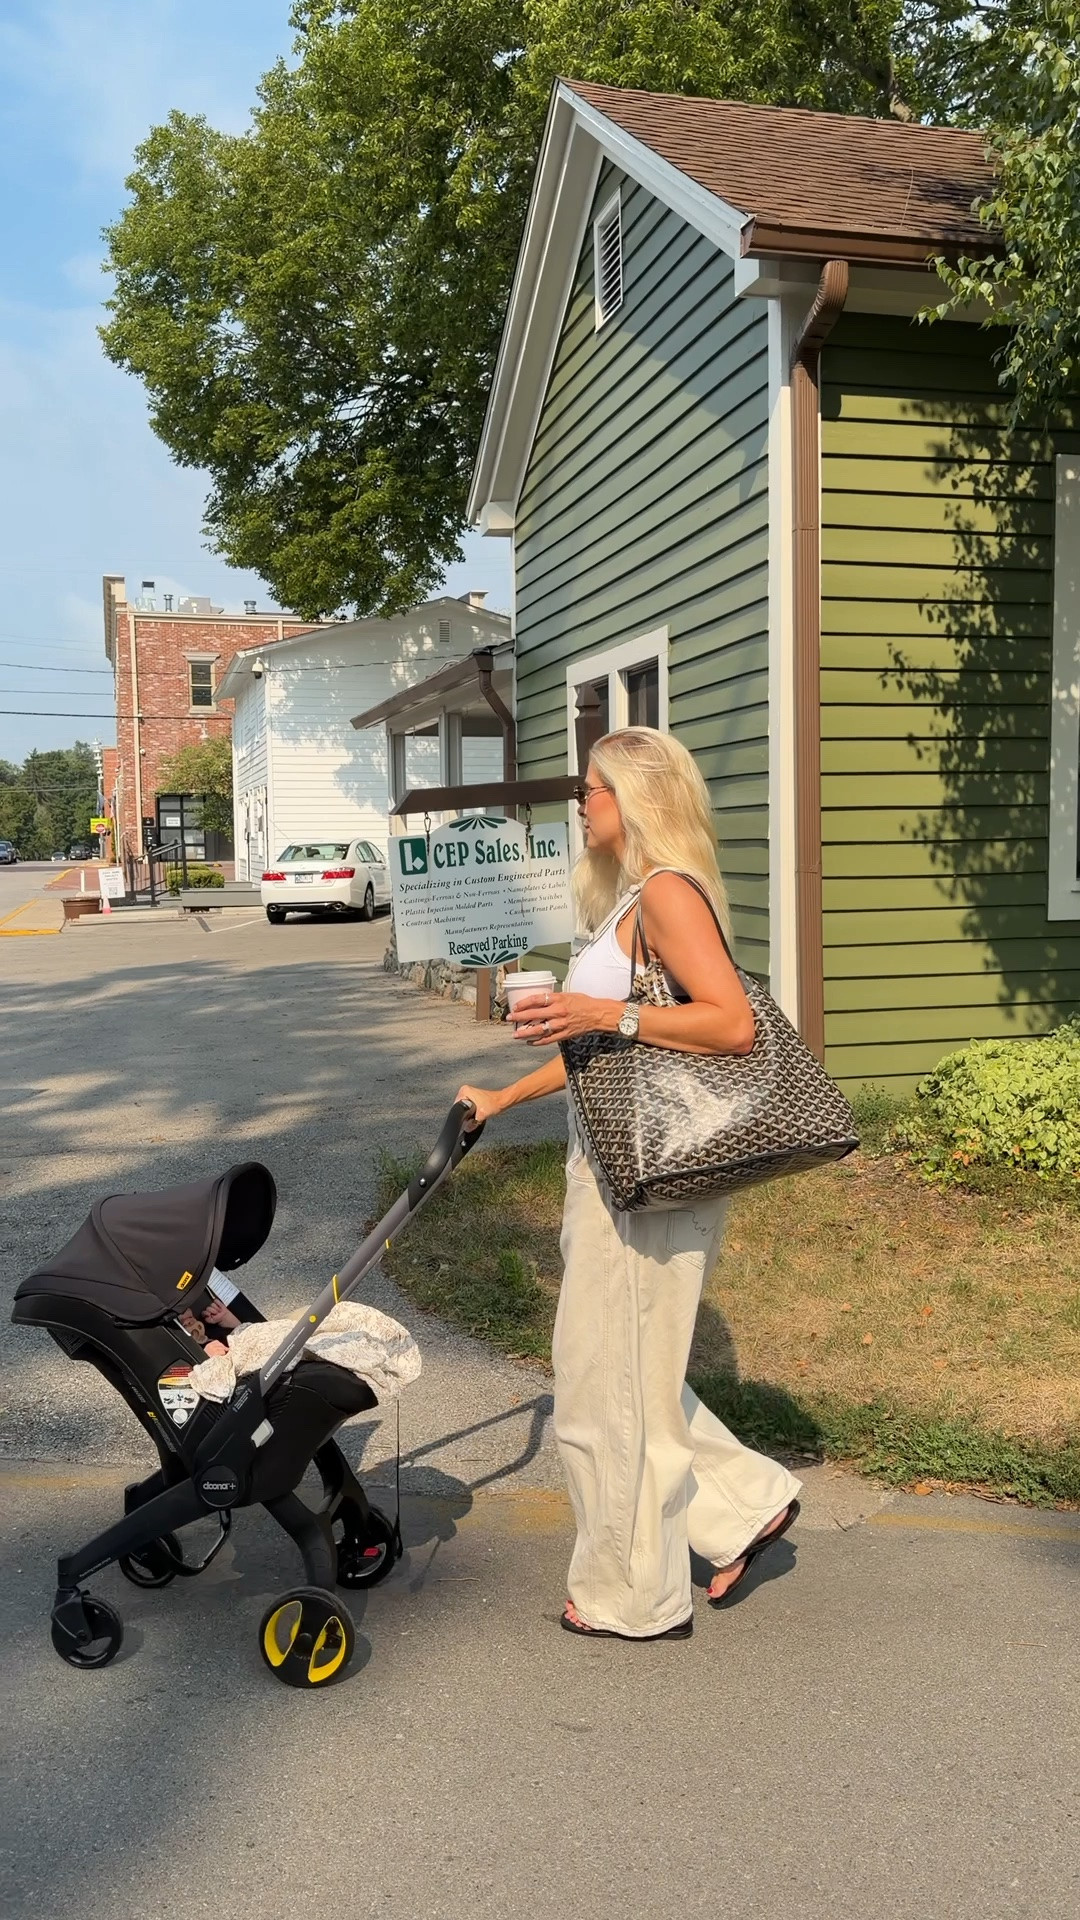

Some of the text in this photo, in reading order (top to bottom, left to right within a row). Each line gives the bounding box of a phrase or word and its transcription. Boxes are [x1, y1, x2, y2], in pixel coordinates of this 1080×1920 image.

[433, 834, 560, 869] CEP Sales, Inc.
[399, 868, 566, 893] Specializing in Custom Engineered Parts
[507, 884, 540, 894] Nameplates
[548, 881, 567, 889] Labels
[507, 893, 563, 904] Membrane Switches
[427, 905, 454, 914] Injection
[455, 901, 477, 910] Molded
[532, 905, 549, 913] Front
[549, 902, 568, 911] Panels
[405, 916, 466, 927] Contract Machining
[444, 920, 534, 935] Manufacturers Representatives
[448, 933, 529, 956] Reserved Parking
